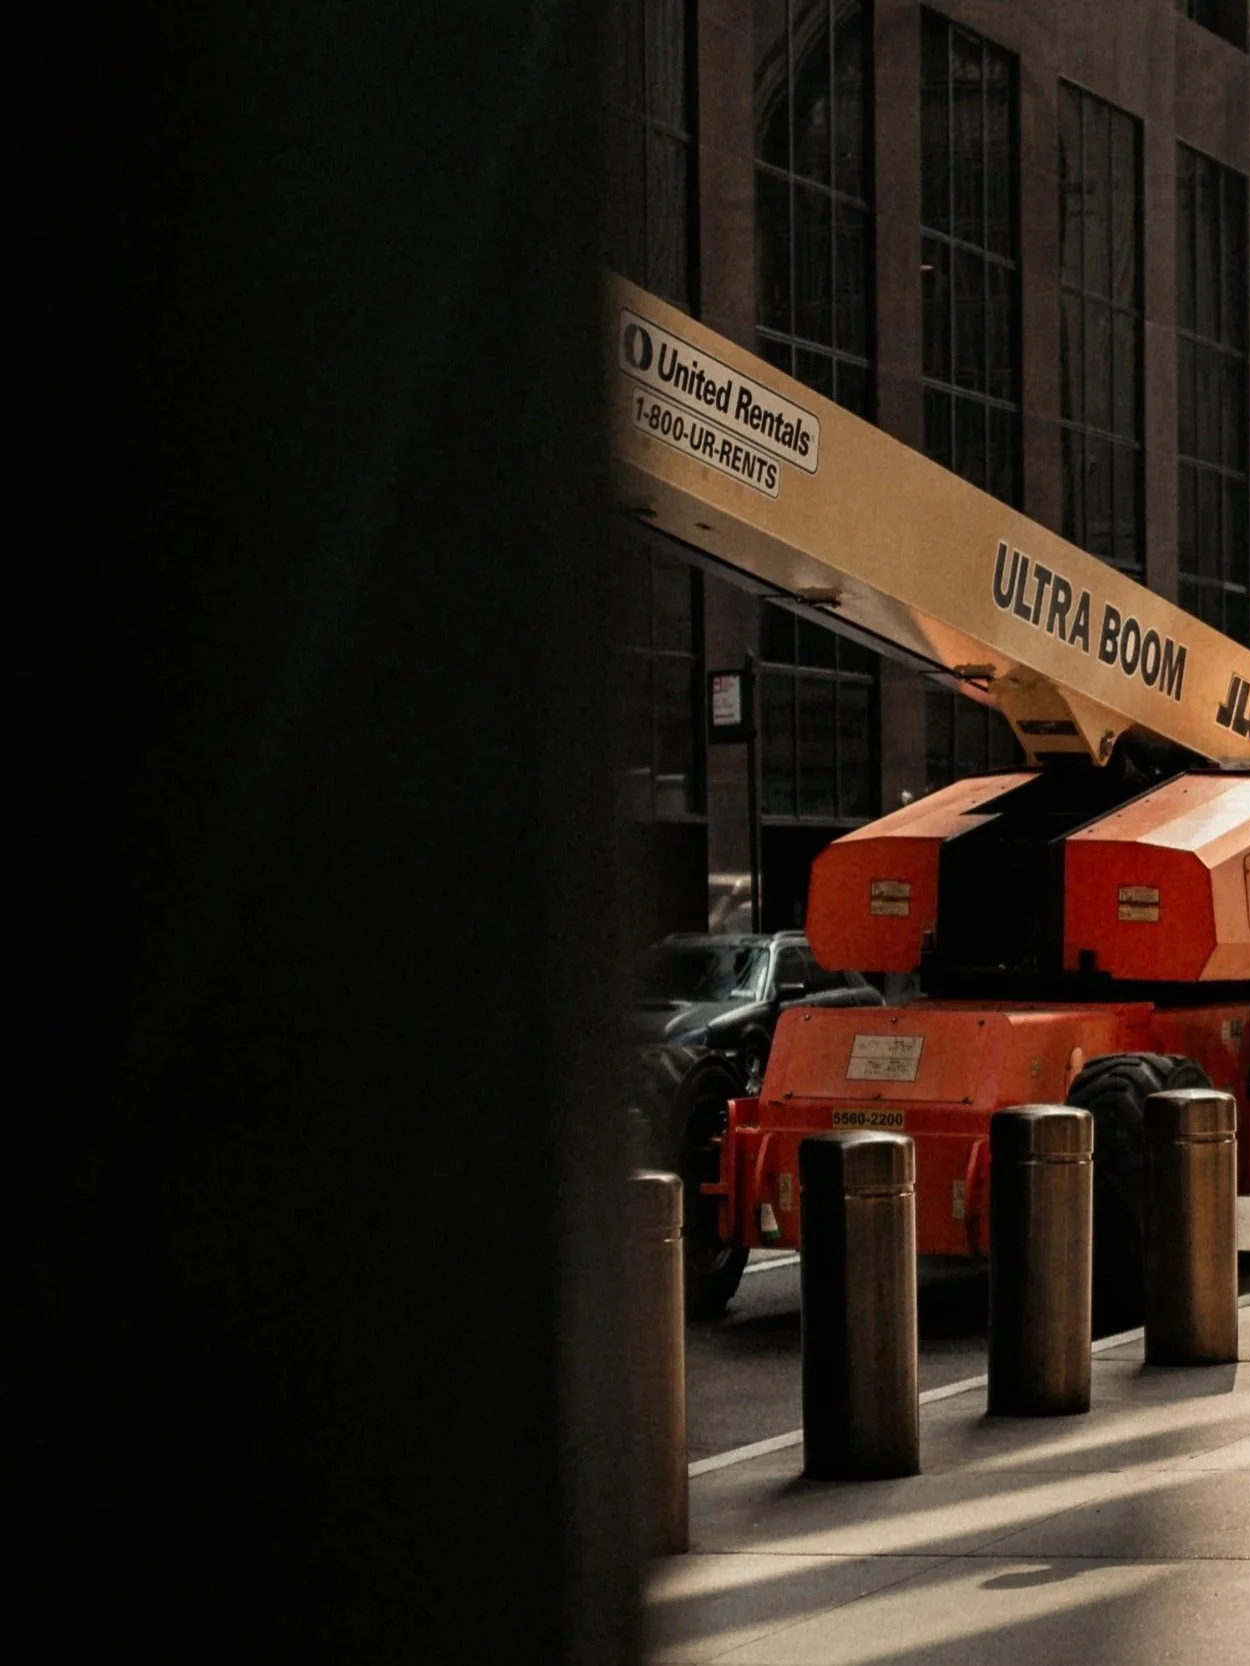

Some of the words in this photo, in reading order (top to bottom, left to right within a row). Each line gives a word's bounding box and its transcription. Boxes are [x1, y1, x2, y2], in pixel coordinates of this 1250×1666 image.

[635, 396, 778, 490] 1-800-UR-RENTS
[658, 343, 732, 415] United
[735, 386, 810, 457] Rentals
[992, 542, 1091, 653] ULTRA
[1098, 603, 1188, 701] BOOM
[833, 1111, 903, 1126] 5560-2200
